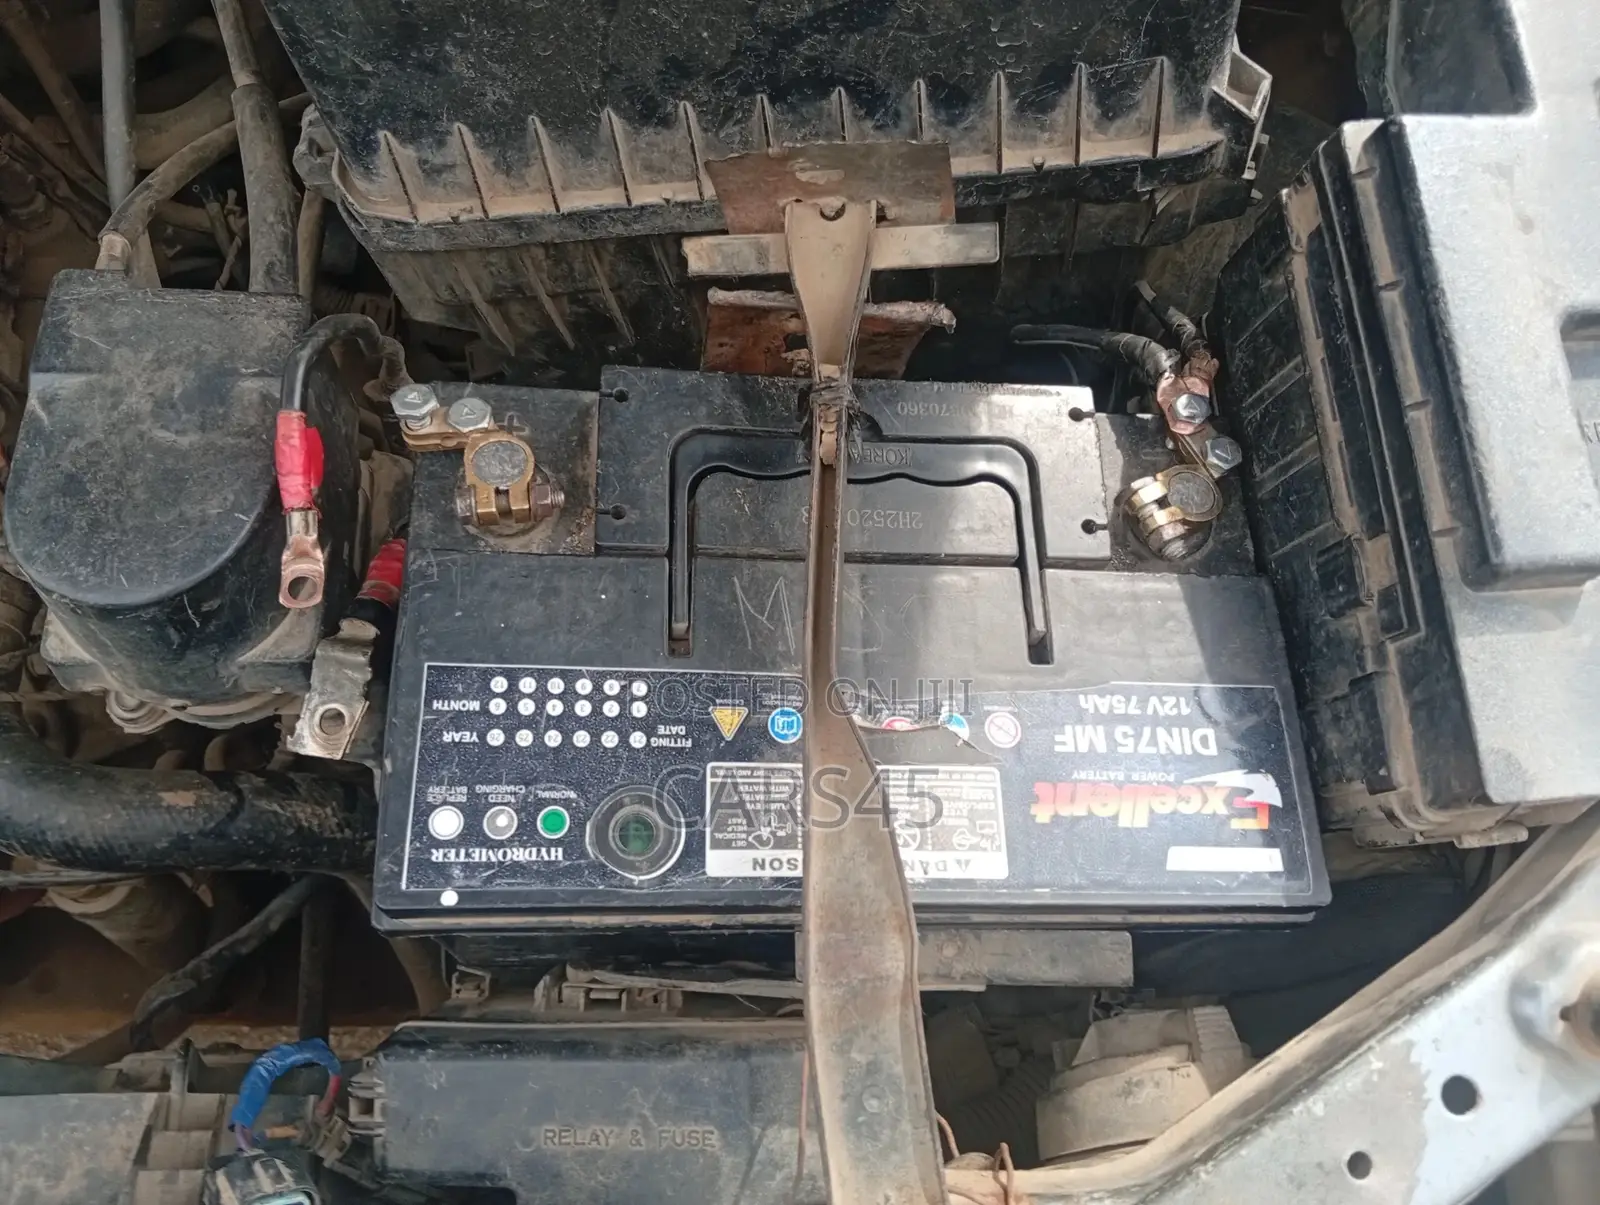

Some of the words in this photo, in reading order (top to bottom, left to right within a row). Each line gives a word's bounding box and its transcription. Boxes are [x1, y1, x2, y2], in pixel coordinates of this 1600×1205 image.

[432, 699, 481, 712] MONTH
[1079, 694, 1142, 715] 75Ah
[1147, 696, 1192, 717] 12V
[657, 724, 686, 735] DATE
[442, 731, 480, 743] YEAR
[650, 736, 693, 748] FITTING
[1054, 724, 1107, 753] MF
[1114, 725, 1219, 756] DIN75
[1071, 768, 1125, 781] BATTERY
[1131, 770, 1176, 783] POWER
[475, 784, 526, 794] CHARGING
[488, 793, 517, 803] NEED
[1030, 782, 1270, 830] Excellent
[430, 847, 564, 862] HYDROMETER
[902, 859, 948, 875] DAN
[543, 1128, 615, 1147] RELAY
[629, 1129, 643, 1148] &
[658, 1129, 717, 1149] FUSE
